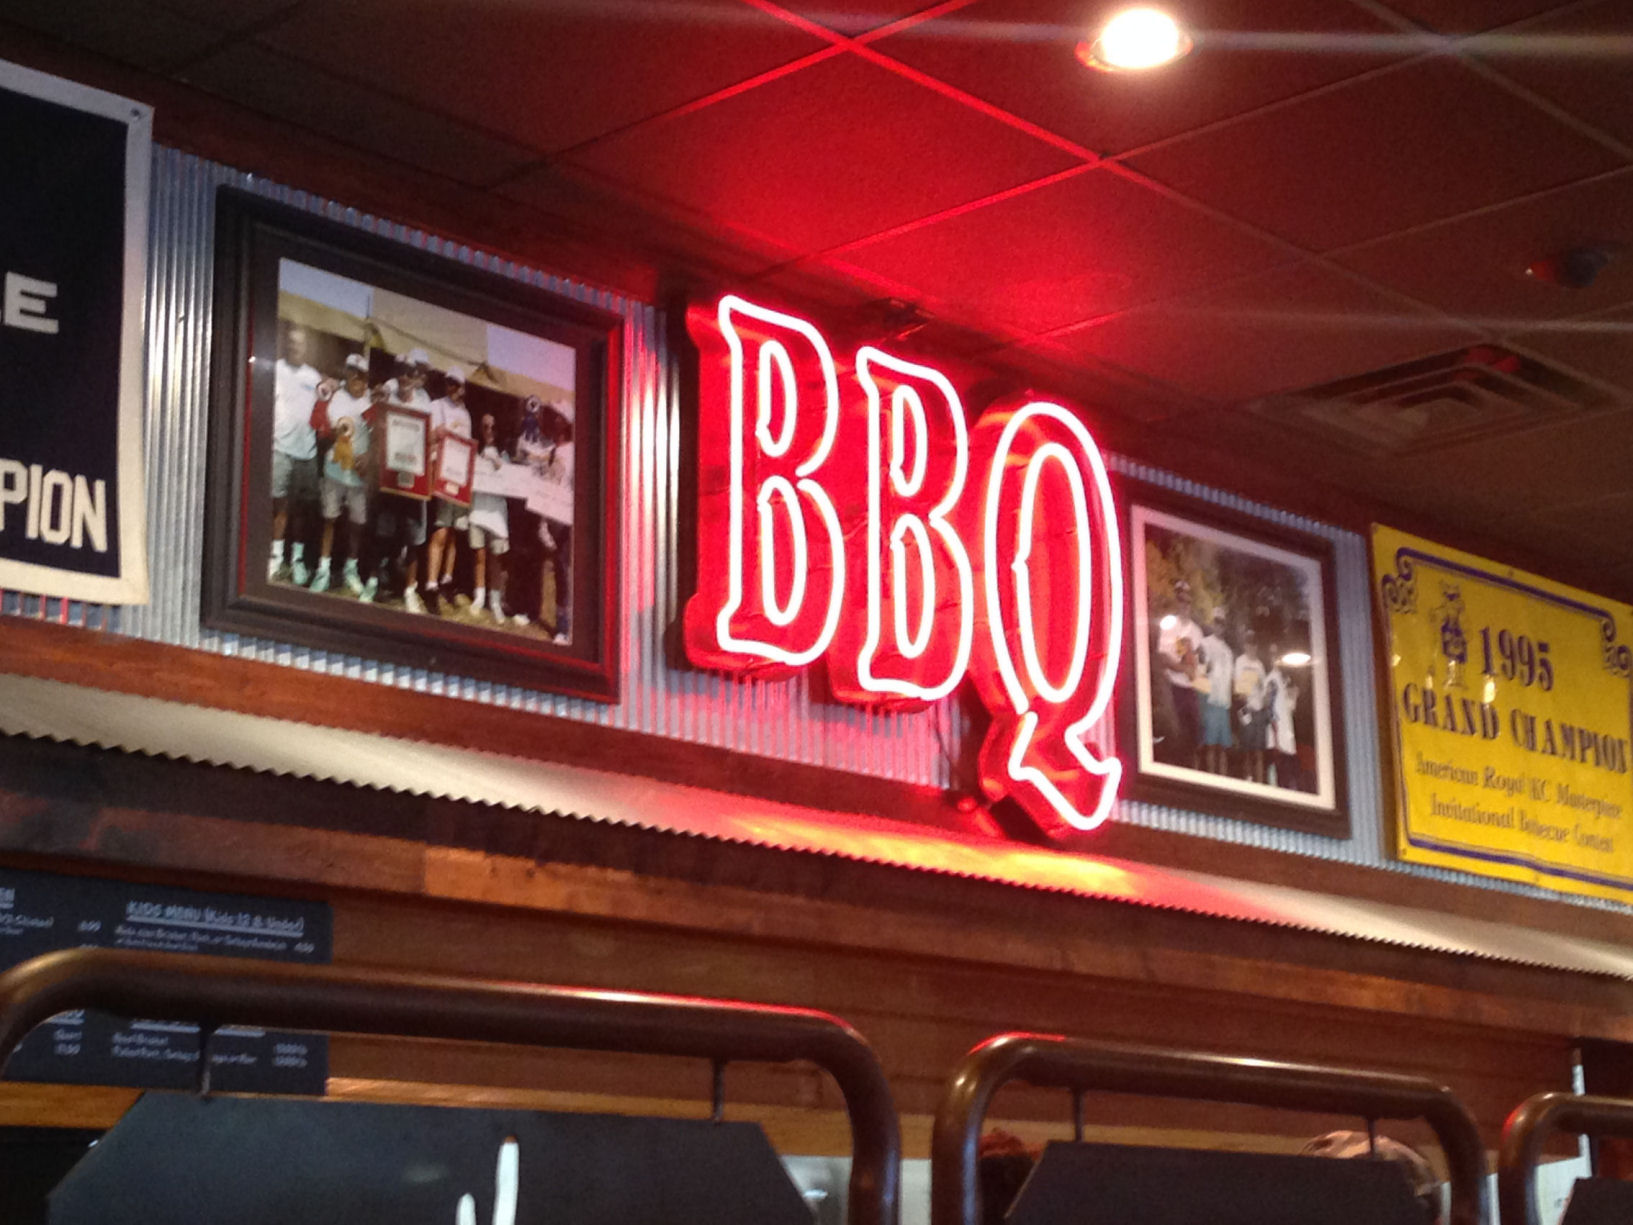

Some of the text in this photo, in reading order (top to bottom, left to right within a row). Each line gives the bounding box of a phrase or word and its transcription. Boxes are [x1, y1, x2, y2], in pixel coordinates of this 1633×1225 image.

[717, 294, 1124, 832] BBQ
[1482, 626, 1554, 691] 1995
[1404, 682, 1628, 774] GRAND CHAMPION
[1416, 752, 1478, 786] American
[1482, 765, 1526, 798] Royal
[1431, 793, 1514, 828] Invitational
